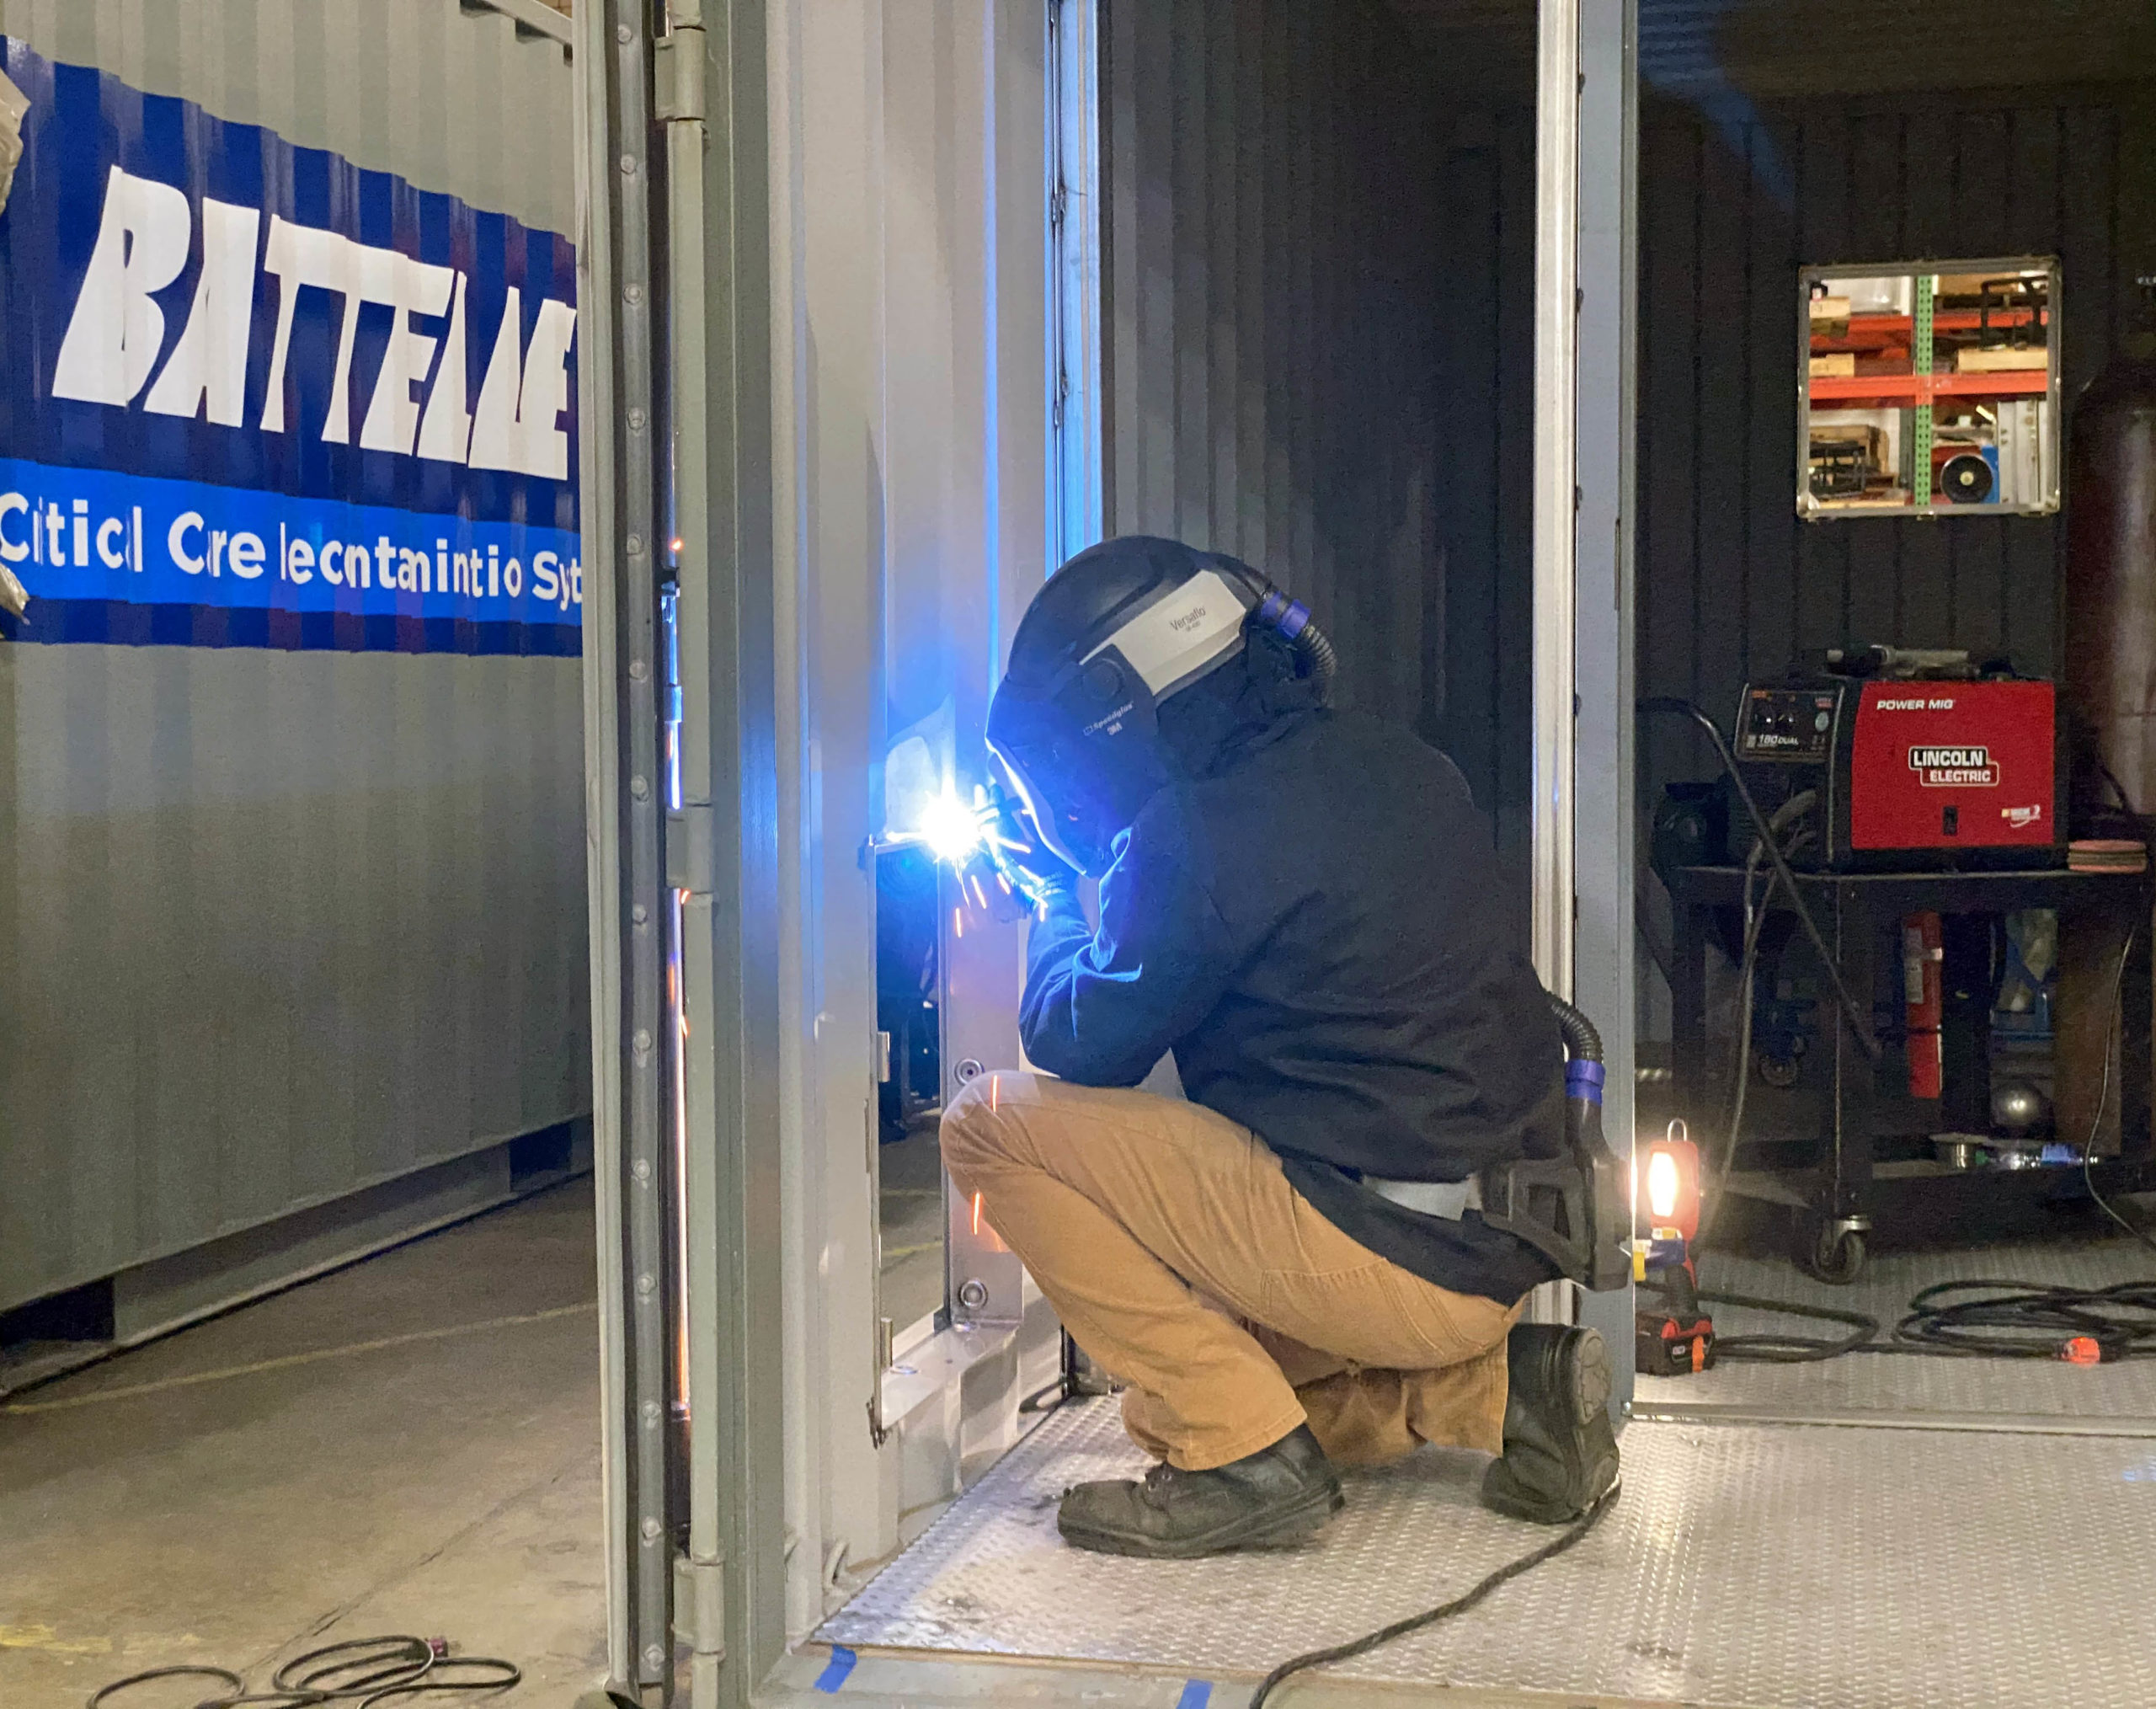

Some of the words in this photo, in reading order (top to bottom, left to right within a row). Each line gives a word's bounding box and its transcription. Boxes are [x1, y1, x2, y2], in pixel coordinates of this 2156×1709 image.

[1876, 699, 1924, 710] POWER
[1928, 699, 1954, 709] MIG
[1913, 750, 1983, 766] LINCOLN
[1929, 770, 1991, 782] ELECTRIC
